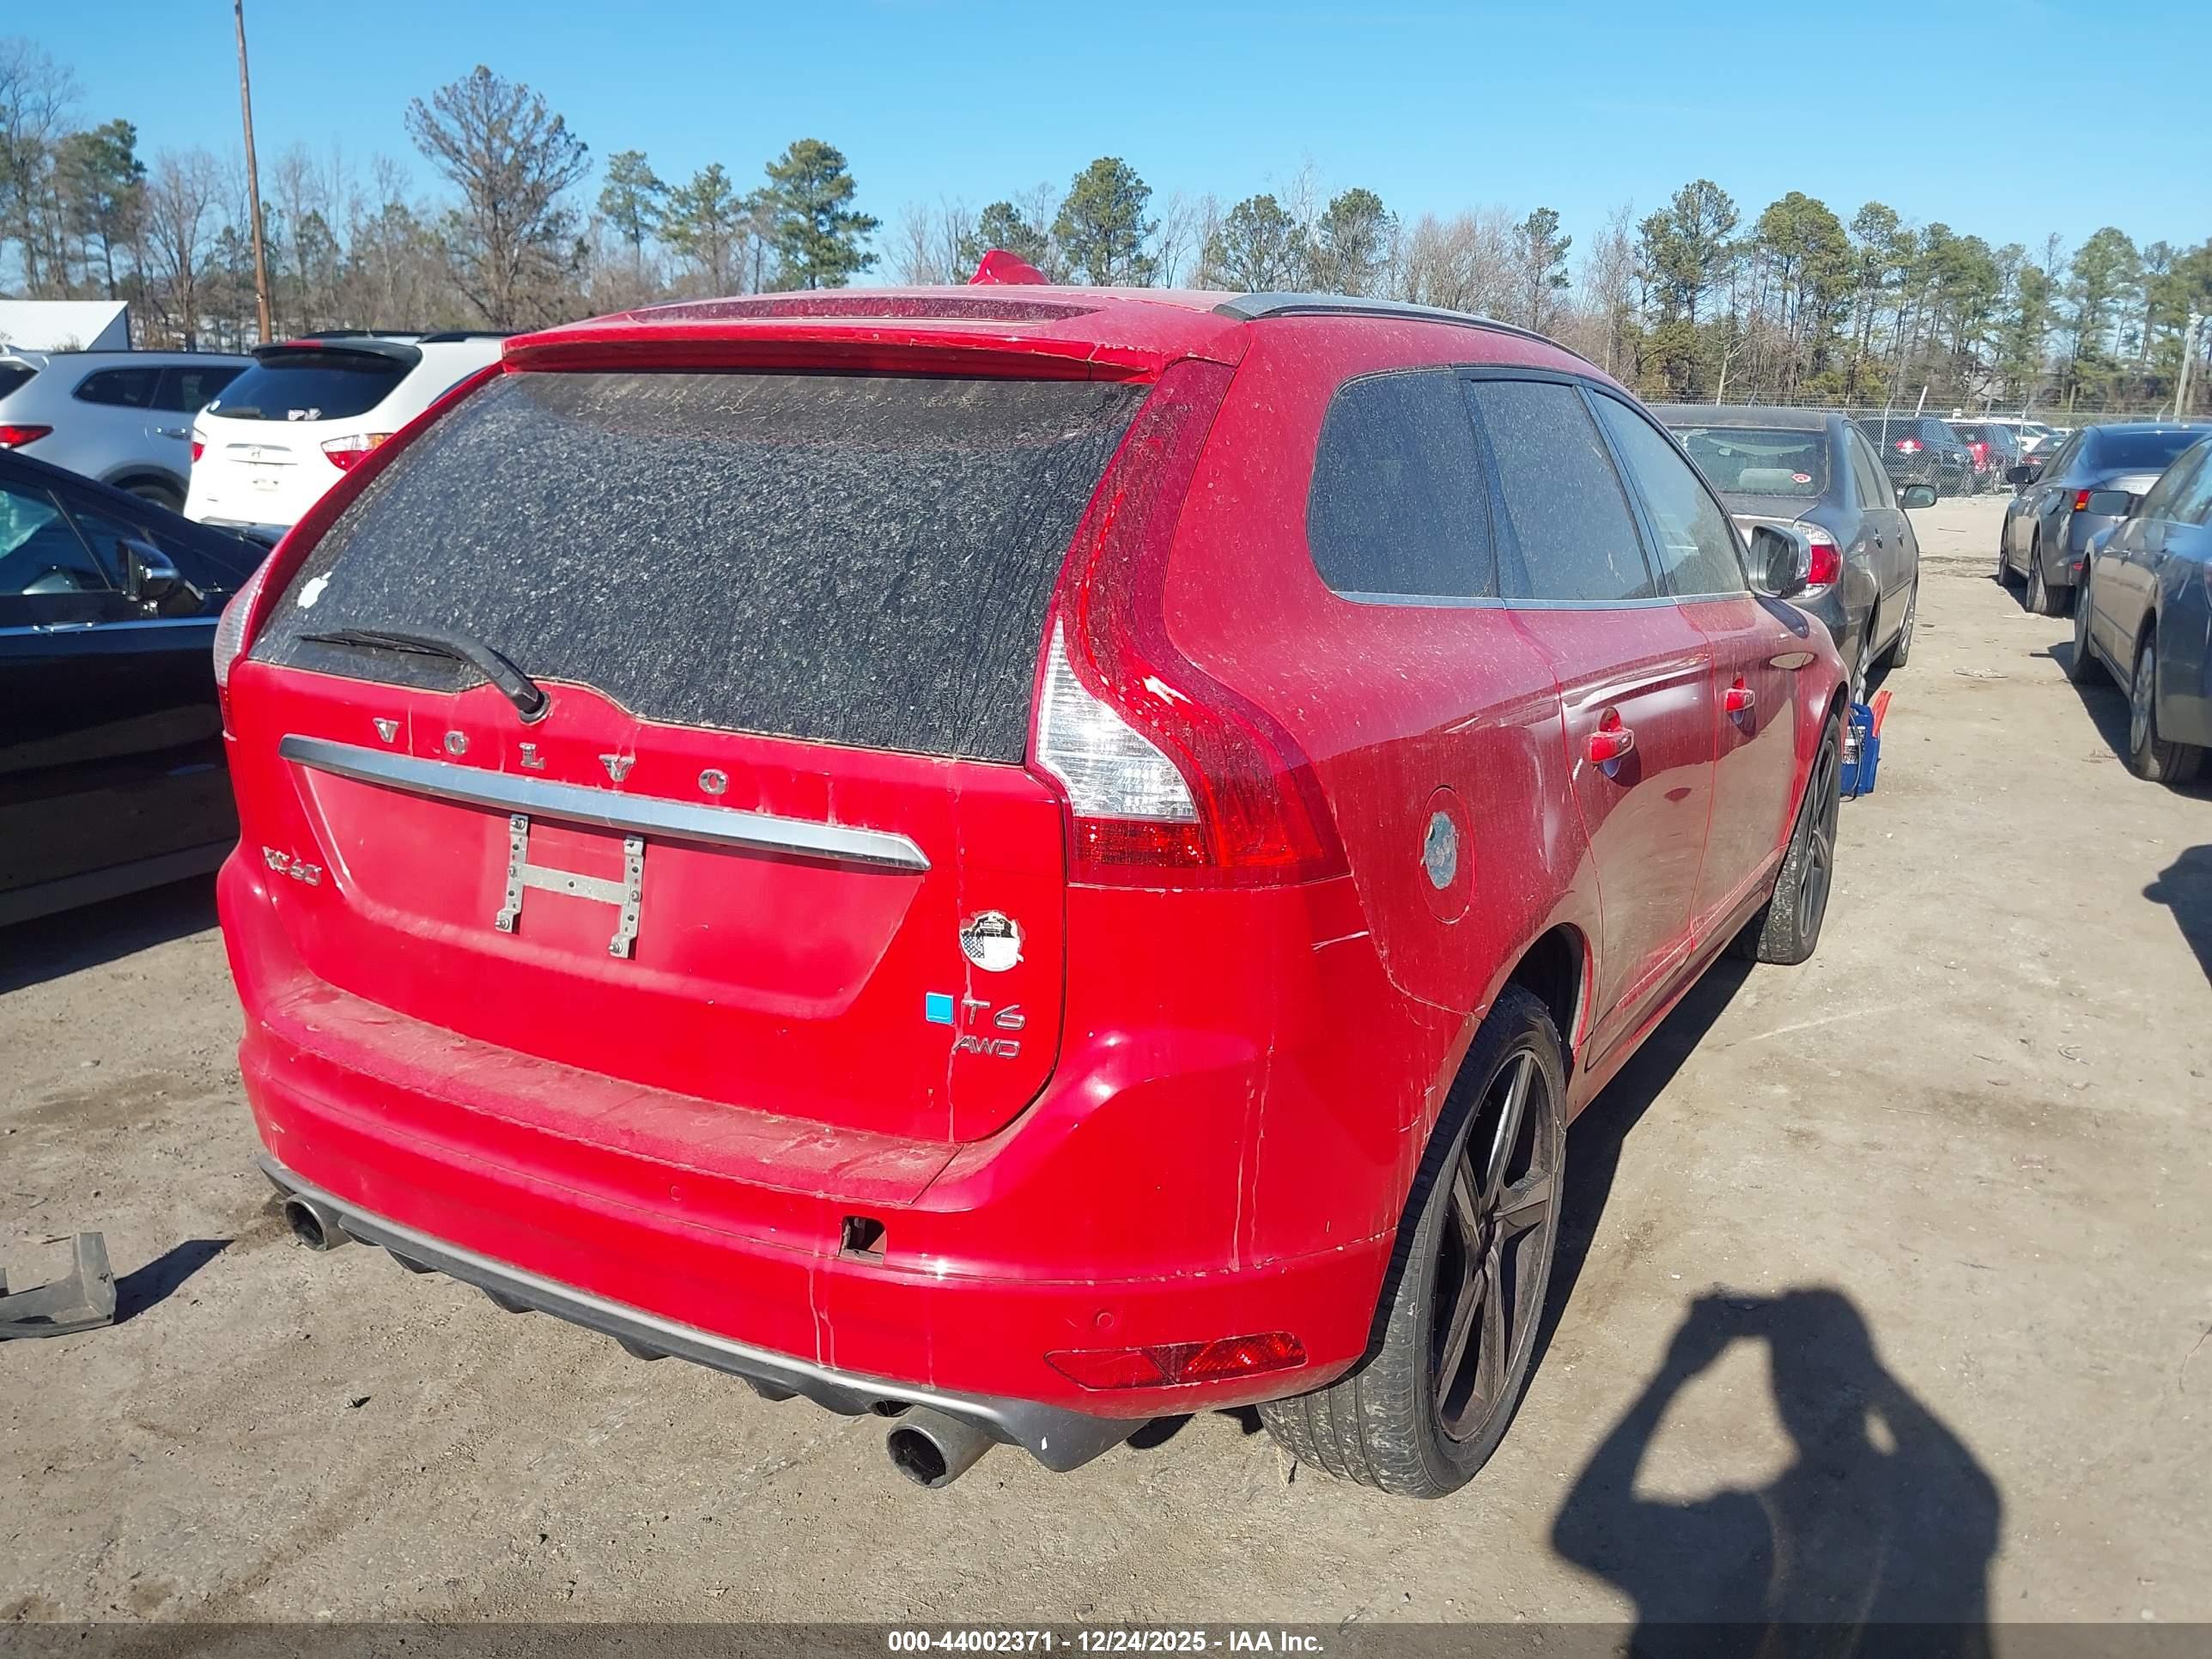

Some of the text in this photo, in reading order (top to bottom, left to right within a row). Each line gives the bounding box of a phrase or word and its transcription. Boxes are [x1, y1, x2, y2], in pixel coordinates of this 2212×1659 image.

[373, 717, 730, 795] VOLVO
[261, 845, 323, 887] XC60
[952, 1035, 1022, 1058] AWD
